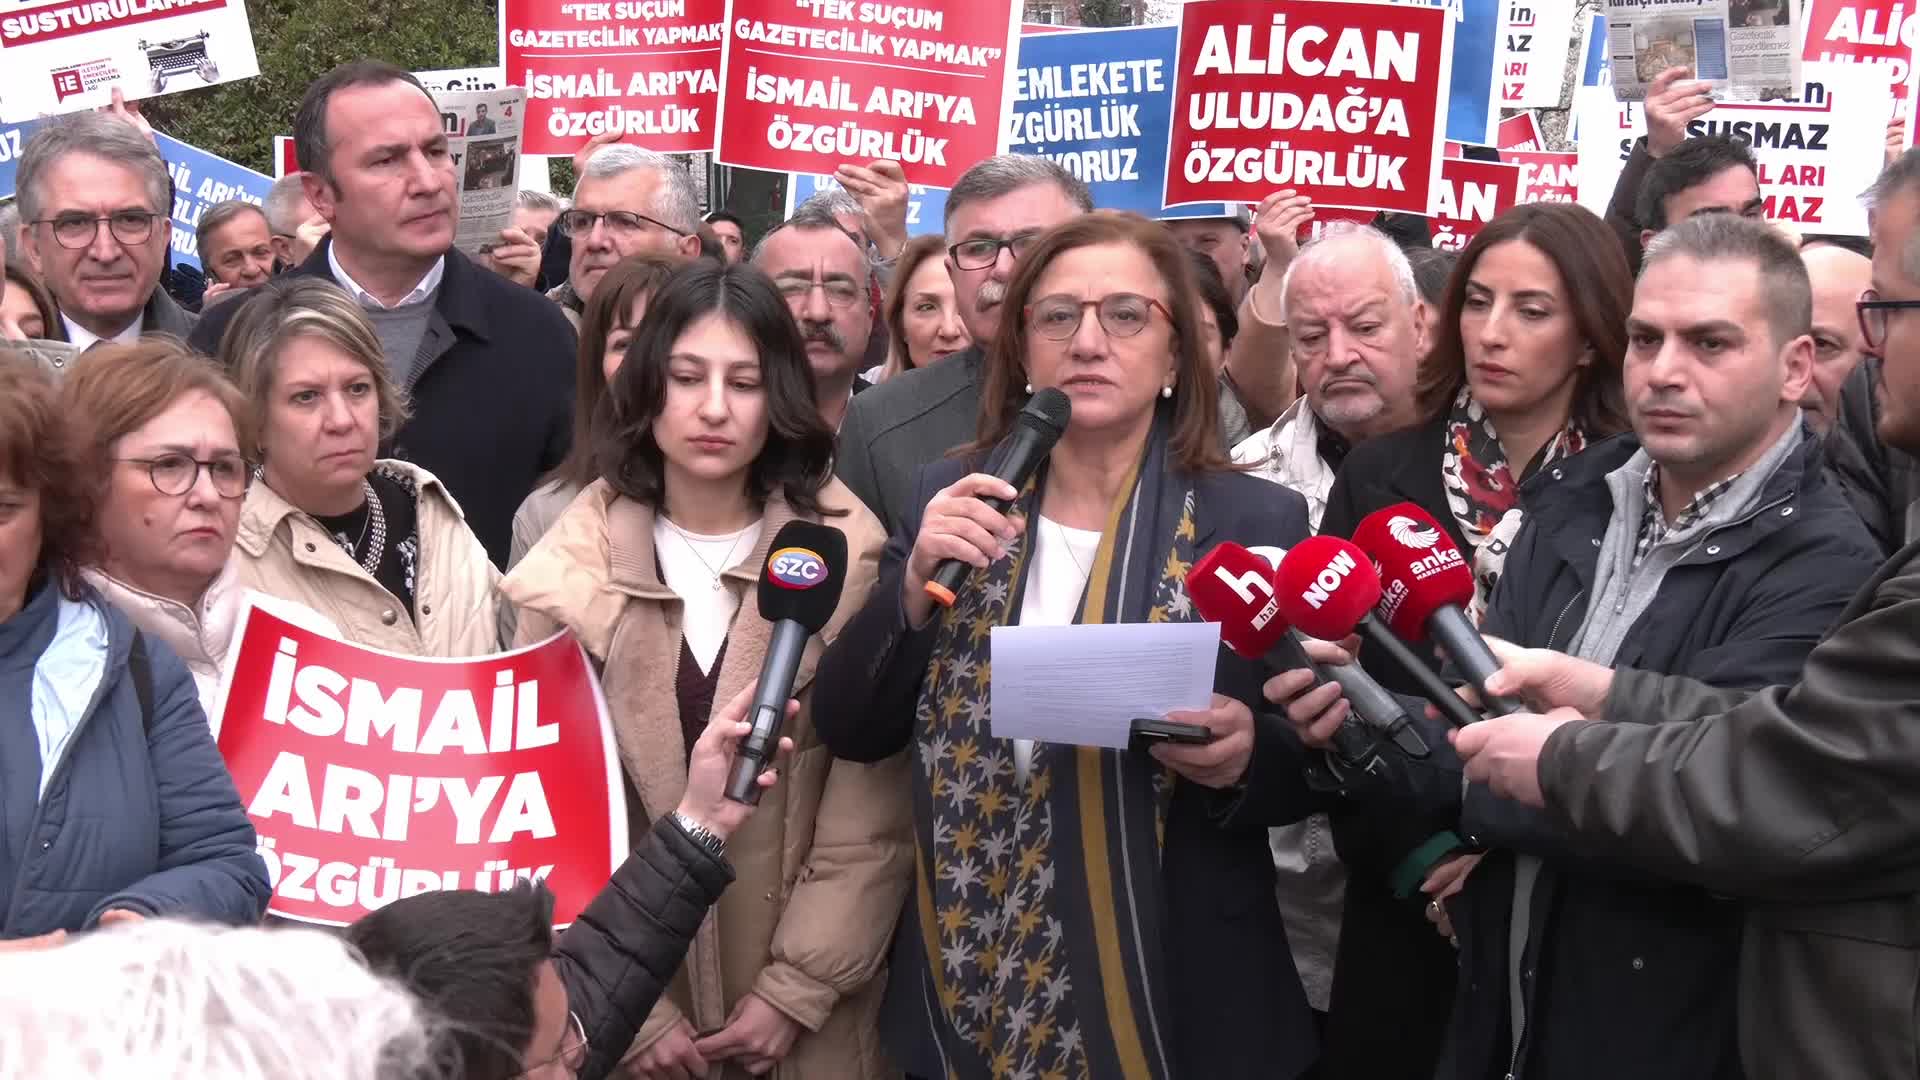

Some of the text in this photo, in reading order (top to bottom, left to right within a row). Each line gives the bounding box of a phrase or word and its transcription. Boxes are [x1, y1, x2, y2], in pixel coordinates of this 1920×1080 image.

[561, 1, 685, 22] “TEK SUÇUM
[858, 2, 944, 31] SUÇUM
[509, 25, 639, 48] GAZETECİLİK
[735, 18, 1001, 67] GAZETECİLİK YAPMAK”
[1193, 13, 1420, 83] ALİCAN
[524, 68, 718, 99] İSMAİL ARI’YA
[745, 66, 976, 125] İSMAİL ARI’YA
[548, 104, 700, 137] ÖZGÜRLÜK
[1188, 86, 1410, 138] ULUDAĞ’A
[767, 114, 949, 167] ÖZGÜRLÜK
[1184, 140, 1408, 192] ÖZGÜRLÜK
[1779, 165, 1826, 187] ARI
[773, 556, 821, 580] SZC
[1302, 549, 1358, 609] NOW
[1409, 547, 1462, 575] anka
[1213, 565, 1275, 606] h
[263, 635, 560, 756] İSMAİL
[248, 750, 557, 846] ARI’YA
